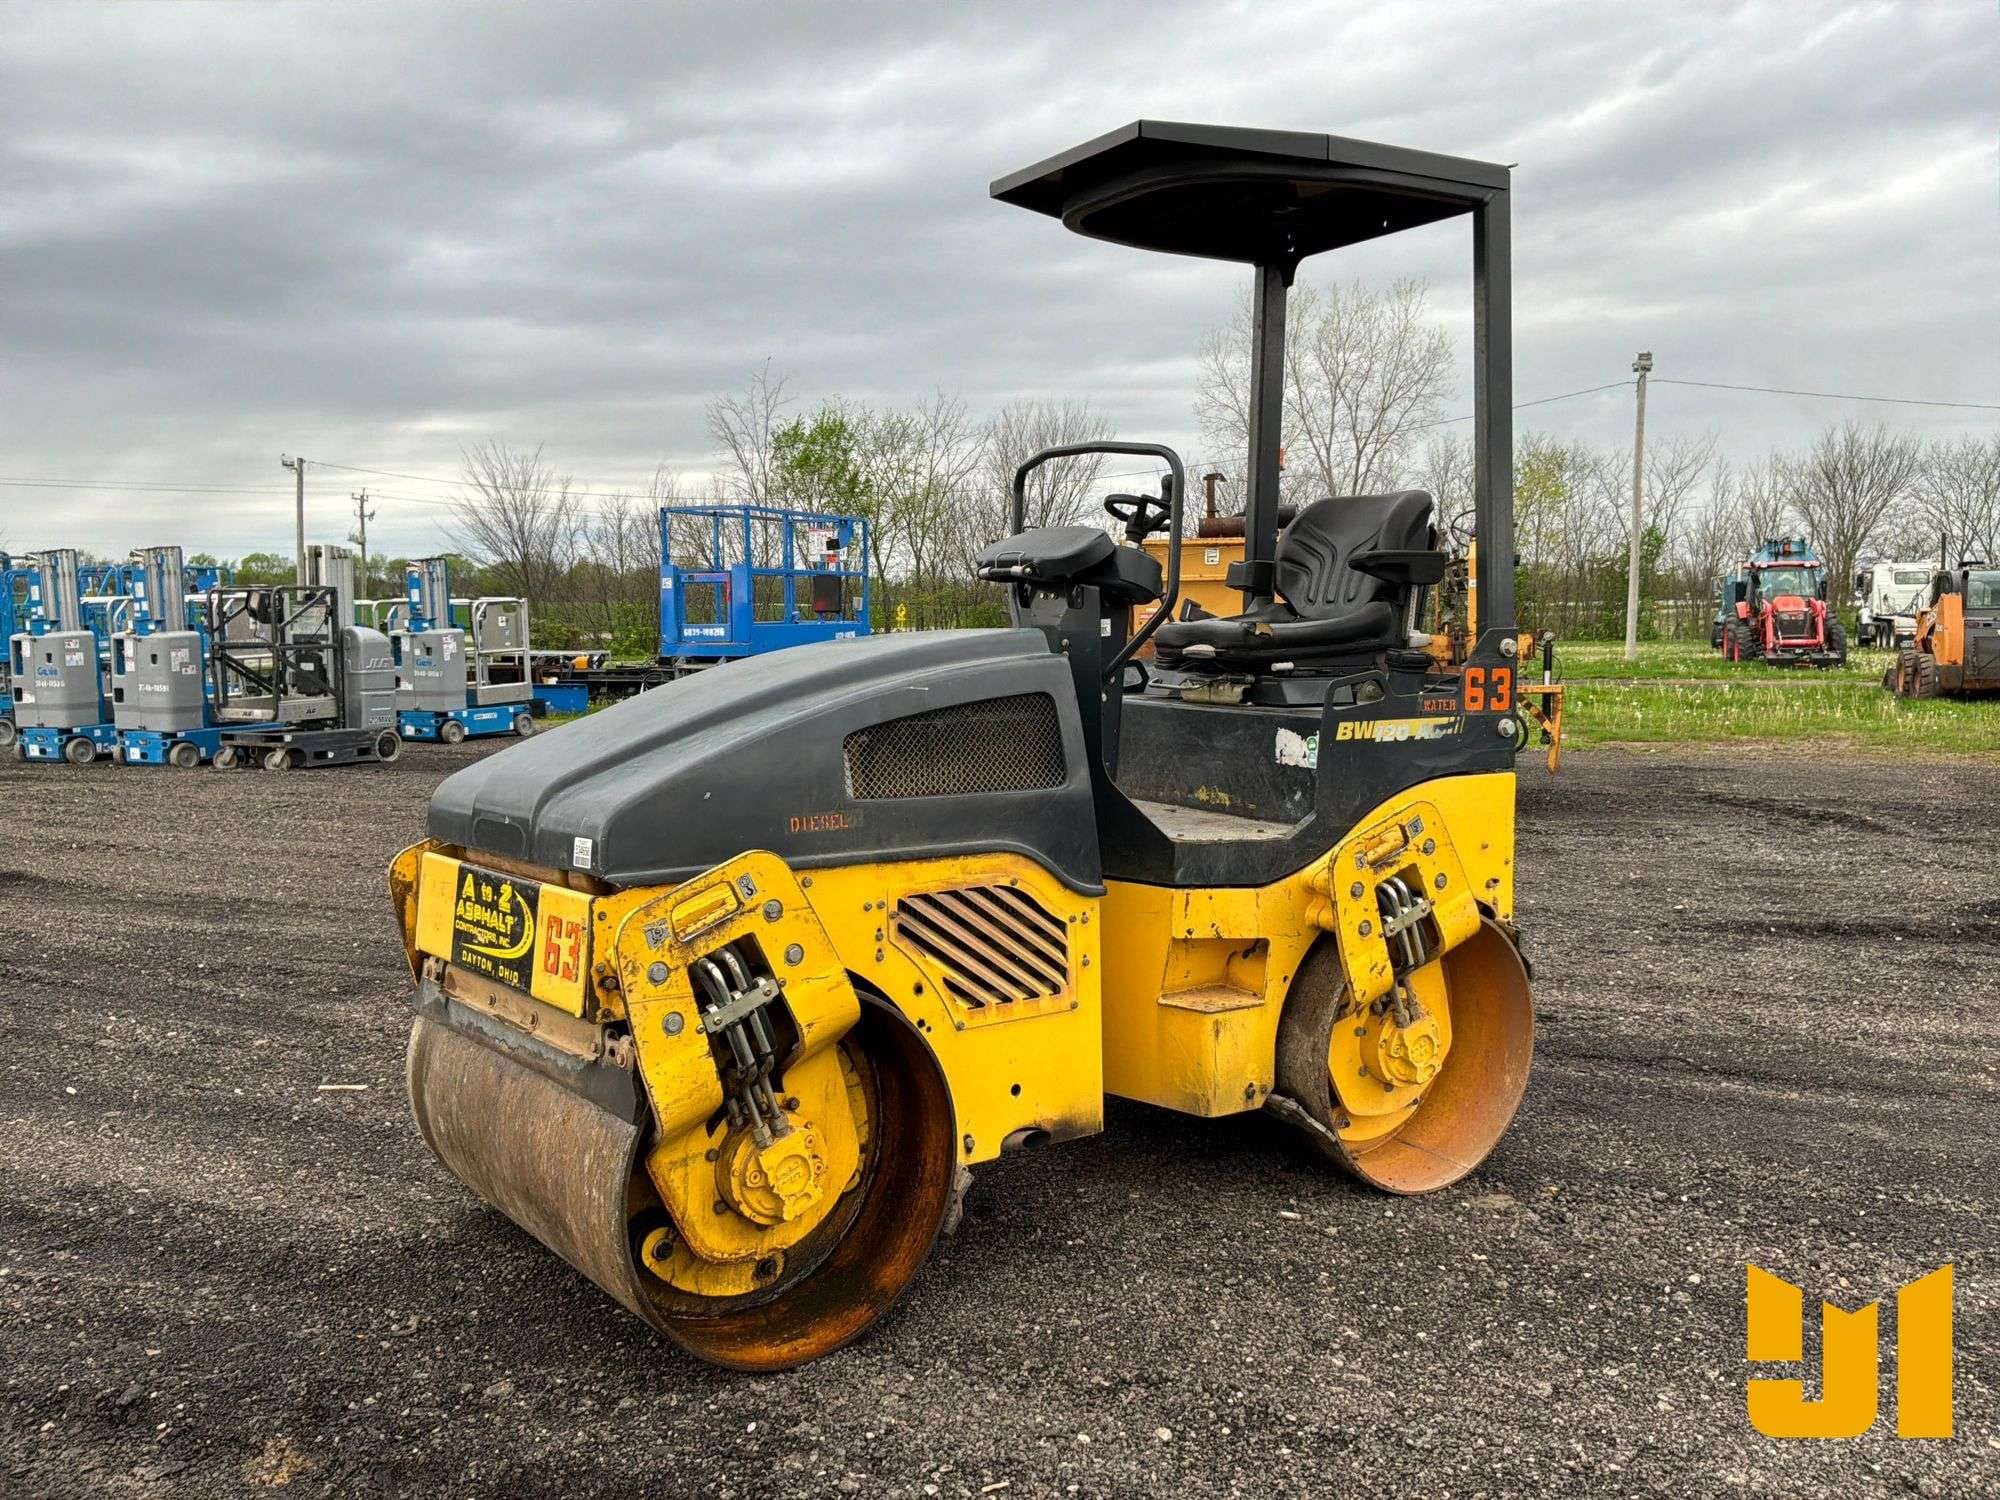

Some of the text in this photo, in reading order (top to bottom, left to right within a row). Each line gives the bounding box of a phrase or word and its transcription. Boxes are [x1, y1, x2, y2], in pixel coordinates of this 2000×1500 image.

[1464, 667, 1512, 712] 63
[1423, 699, 1457, 712] WATER
[789, 814, 849, 832] DIESEL
[462, 873, 475, 901] A
[456, 899, 514, 934] ASPHALT
[543, 914, 581, 983] 63
[498, 966, 519, 984] OHIO
